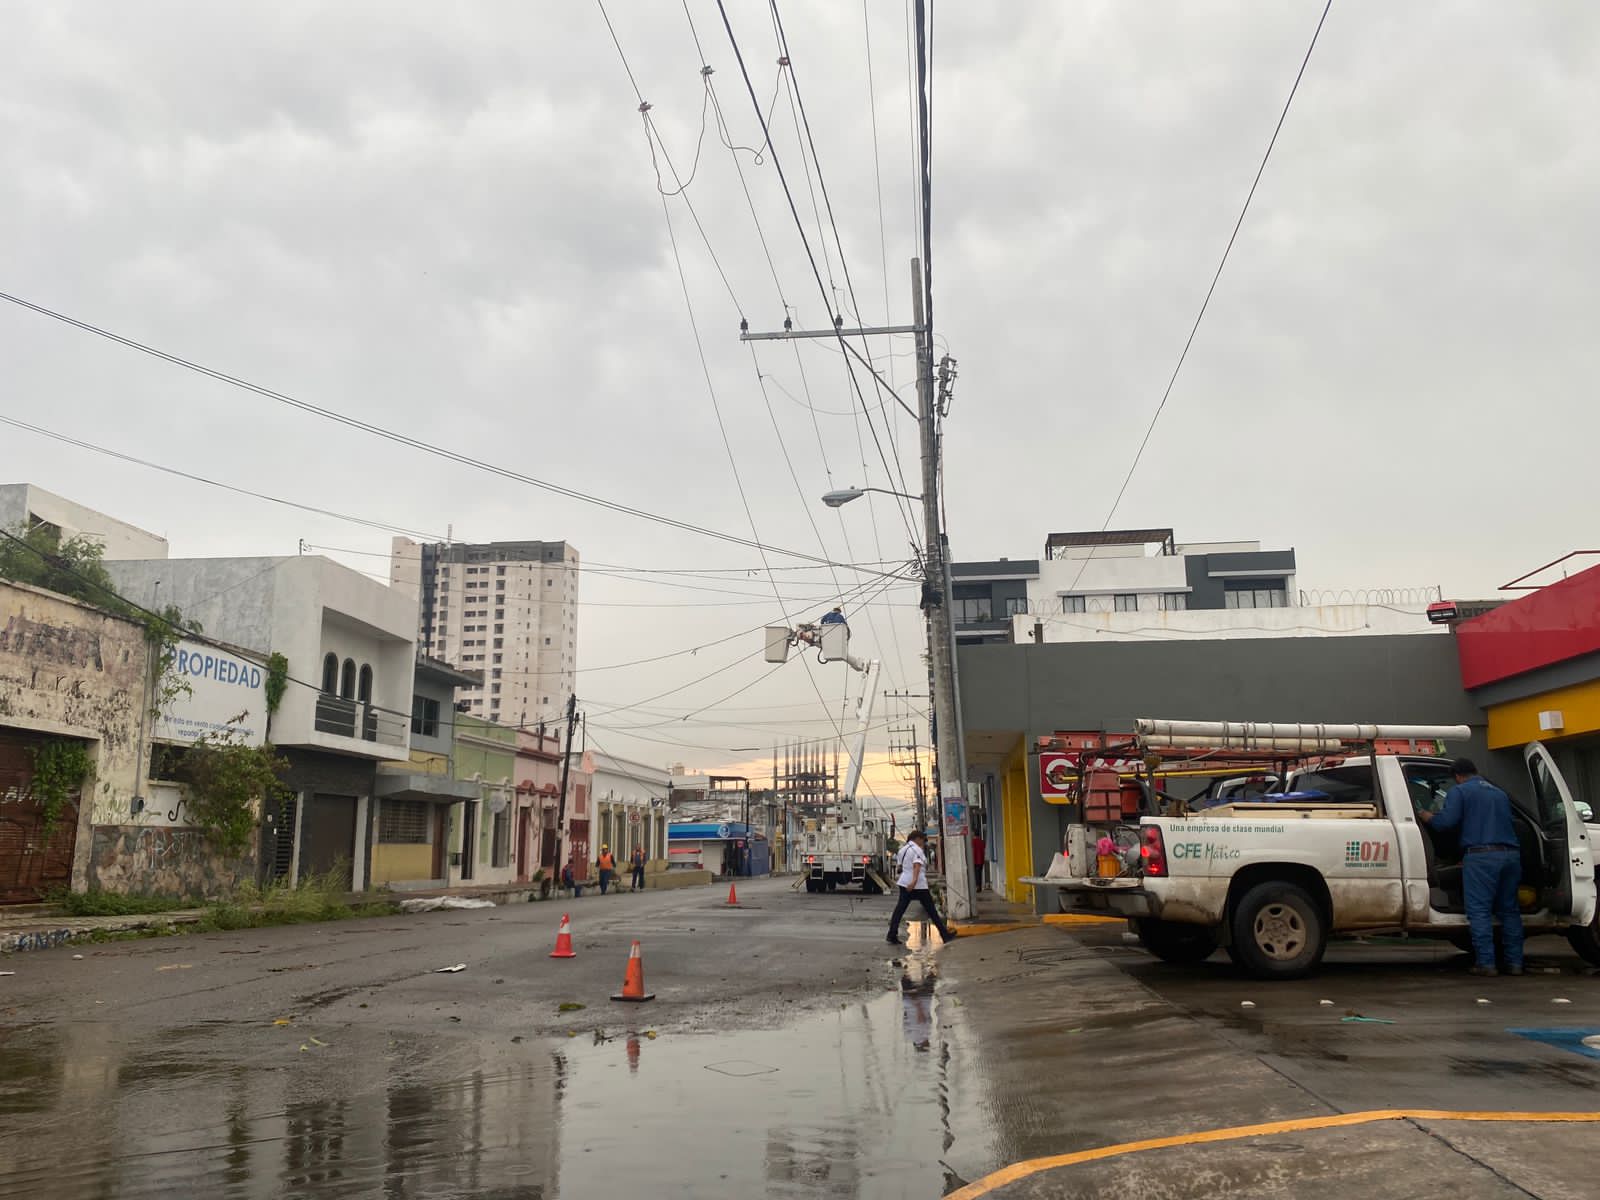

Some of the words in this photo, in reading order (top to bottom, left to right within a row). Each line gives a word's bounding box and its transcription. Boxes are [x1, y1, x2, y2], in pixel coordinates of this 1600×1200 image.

[168, 646, 261, 689] PROPIEDAD
[1169, 824, 1185, 833] Una
[1187, 824, 1219, 834] empresa
[1221, 824, 1231, 833] de
[1233, 824, 1252, 833] clase
[1254, 824, 1284, 833] mundial
[1173, 843, 1202, 859] CFE
[1361, 841, 1389, 861] 071
